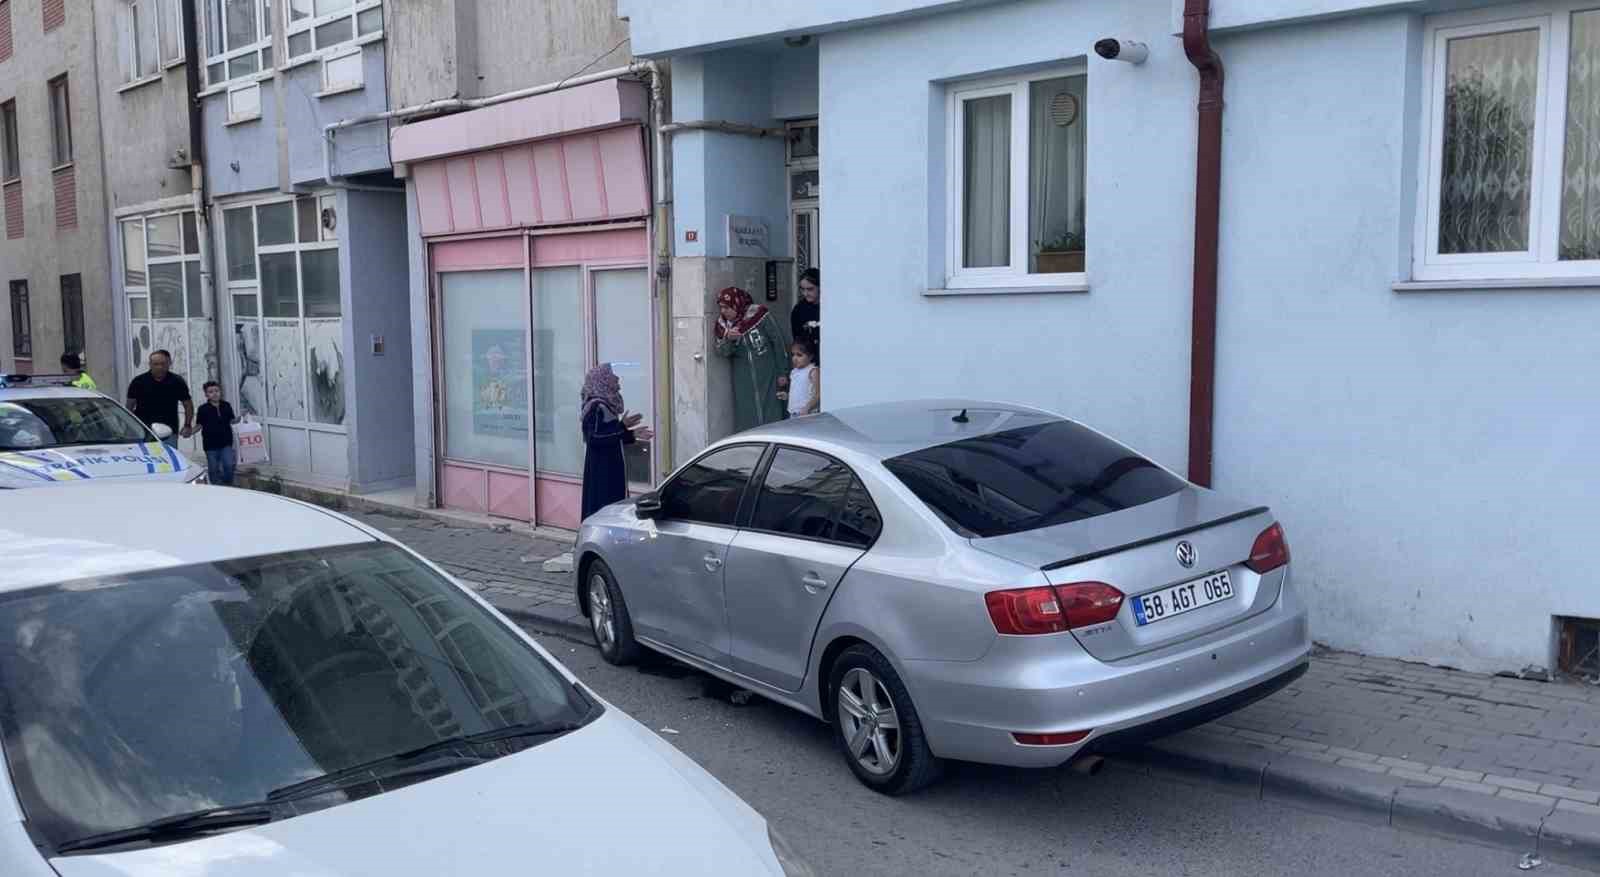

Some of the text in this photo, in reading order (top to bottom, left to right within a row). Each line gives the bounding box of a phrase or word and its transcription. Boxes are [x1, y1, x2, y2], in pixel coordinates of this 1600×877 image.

[240, 434, 263, 446] FLO
[1143, 595, 1165, 620] 58
[1171, 584, 1198, 612] AGT
[1203, 575, 1231, 601] 065
